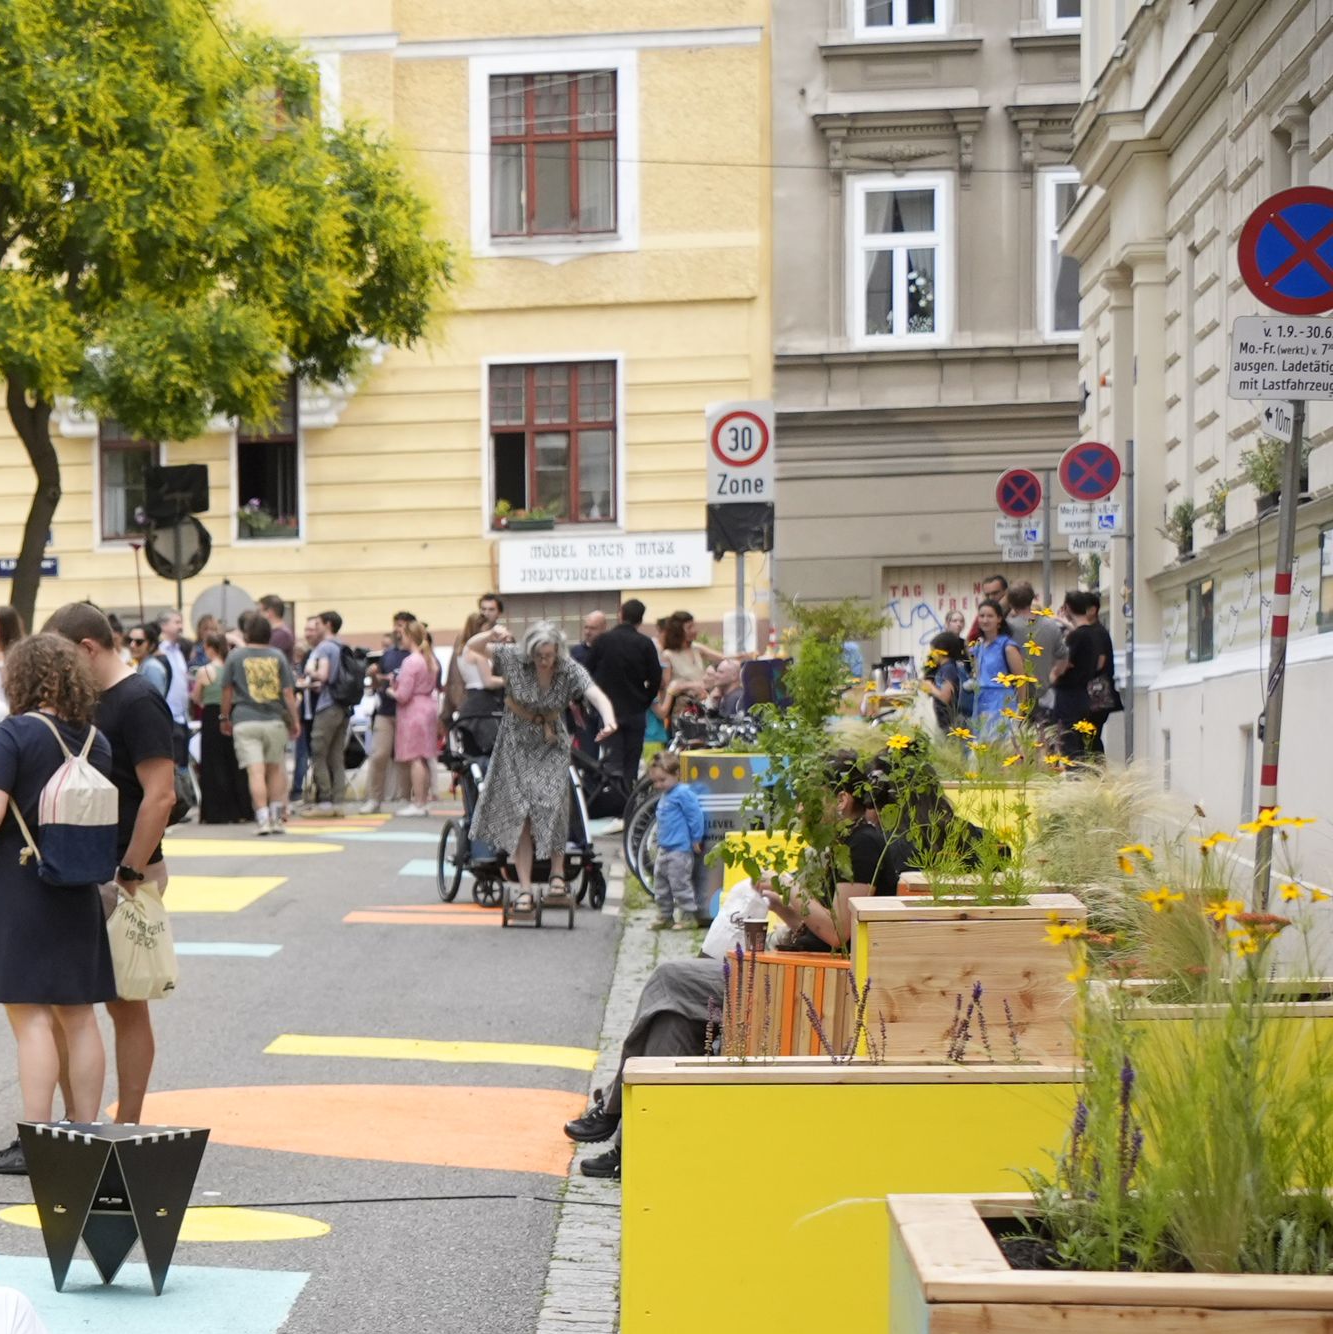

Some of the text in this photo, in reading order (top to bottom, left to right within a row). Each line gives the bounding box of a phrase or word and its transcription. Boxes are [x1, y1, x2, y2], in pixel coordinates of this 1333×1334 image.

[1234, 362, 1278, 374] ausgen.
[1239, 378, 1258, 390] mit
[1275, 407, 1291, 435] 10m
[728, 426, 752, 452] 30
[717, 473, 764, 495] Zone
